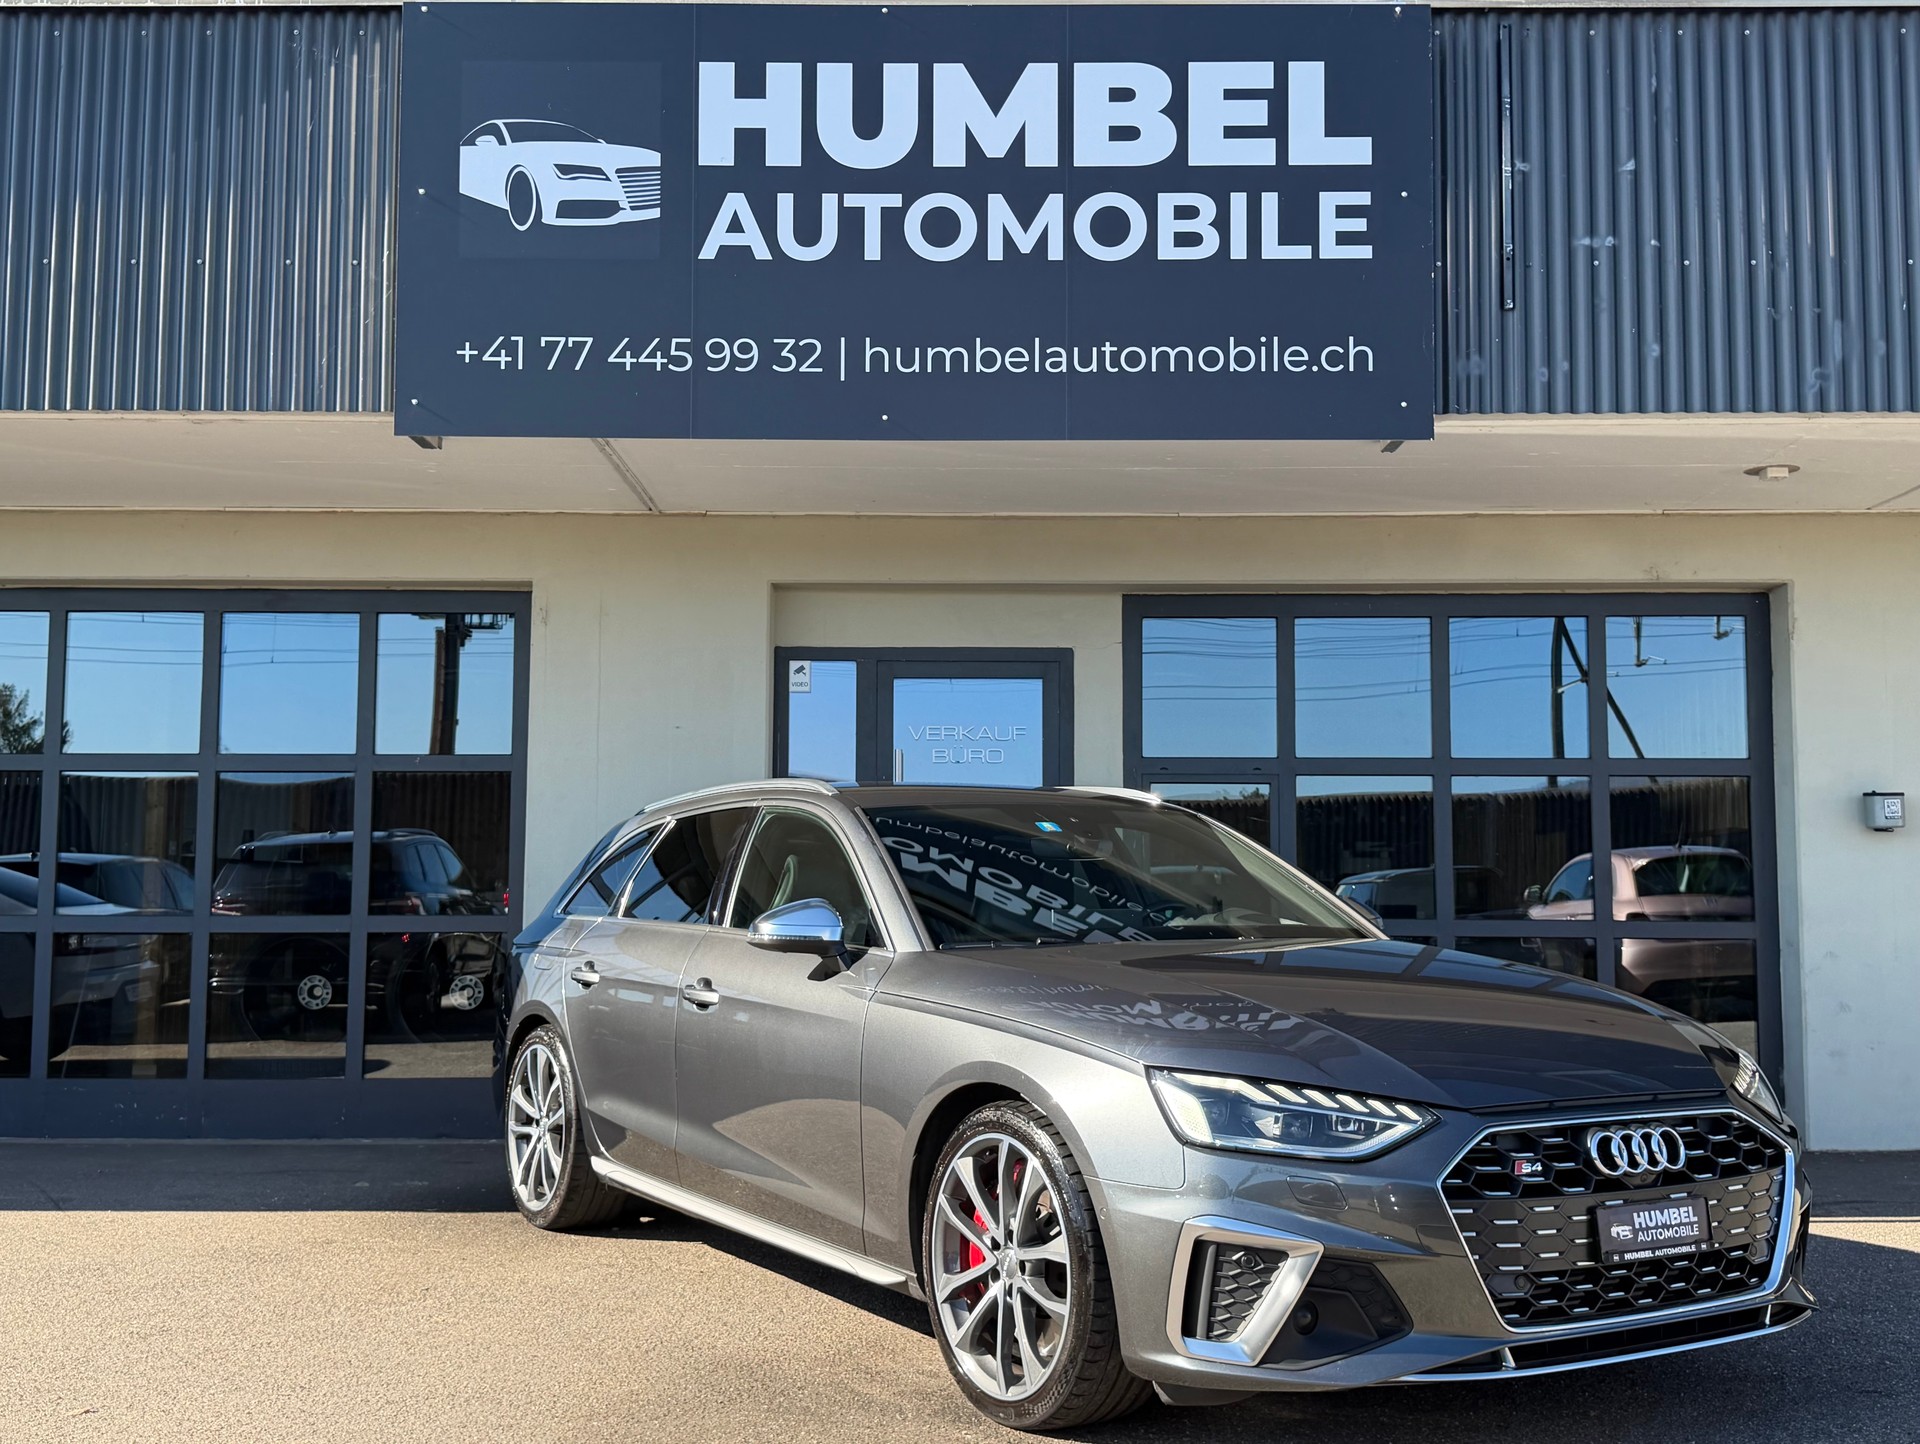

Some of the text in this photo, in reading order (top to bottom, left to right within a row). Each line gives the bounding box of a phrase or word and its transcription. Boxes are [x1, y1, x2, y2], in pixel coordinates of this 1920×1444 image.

[698, 61, 1373, 170] HUMBEL
[697, 191, 1373, 262] AUTOMOBILE
[456, 335, 524, 370] +41
[540, 336, 594, 371] 77
[607, 337, 693, 372] 445
[704, 337, 759, 372] 99
[771, 338, 824, 373] 32
[865, 336, 1374, 373] humbelautomobile.ch
[908, 725, 1027, 741] VERKAUF
[932, 745, 1004, 764] BÜRO
[1520, 1161, 1543, 1173] S4
[1633, 1206, 1698, 1229] HUMBEL
[1637, 1224, 1699, 1242] AUTOMOBILE
[1624, 1245, 1696, 1261] HUMBEL AUTOMOBILE
